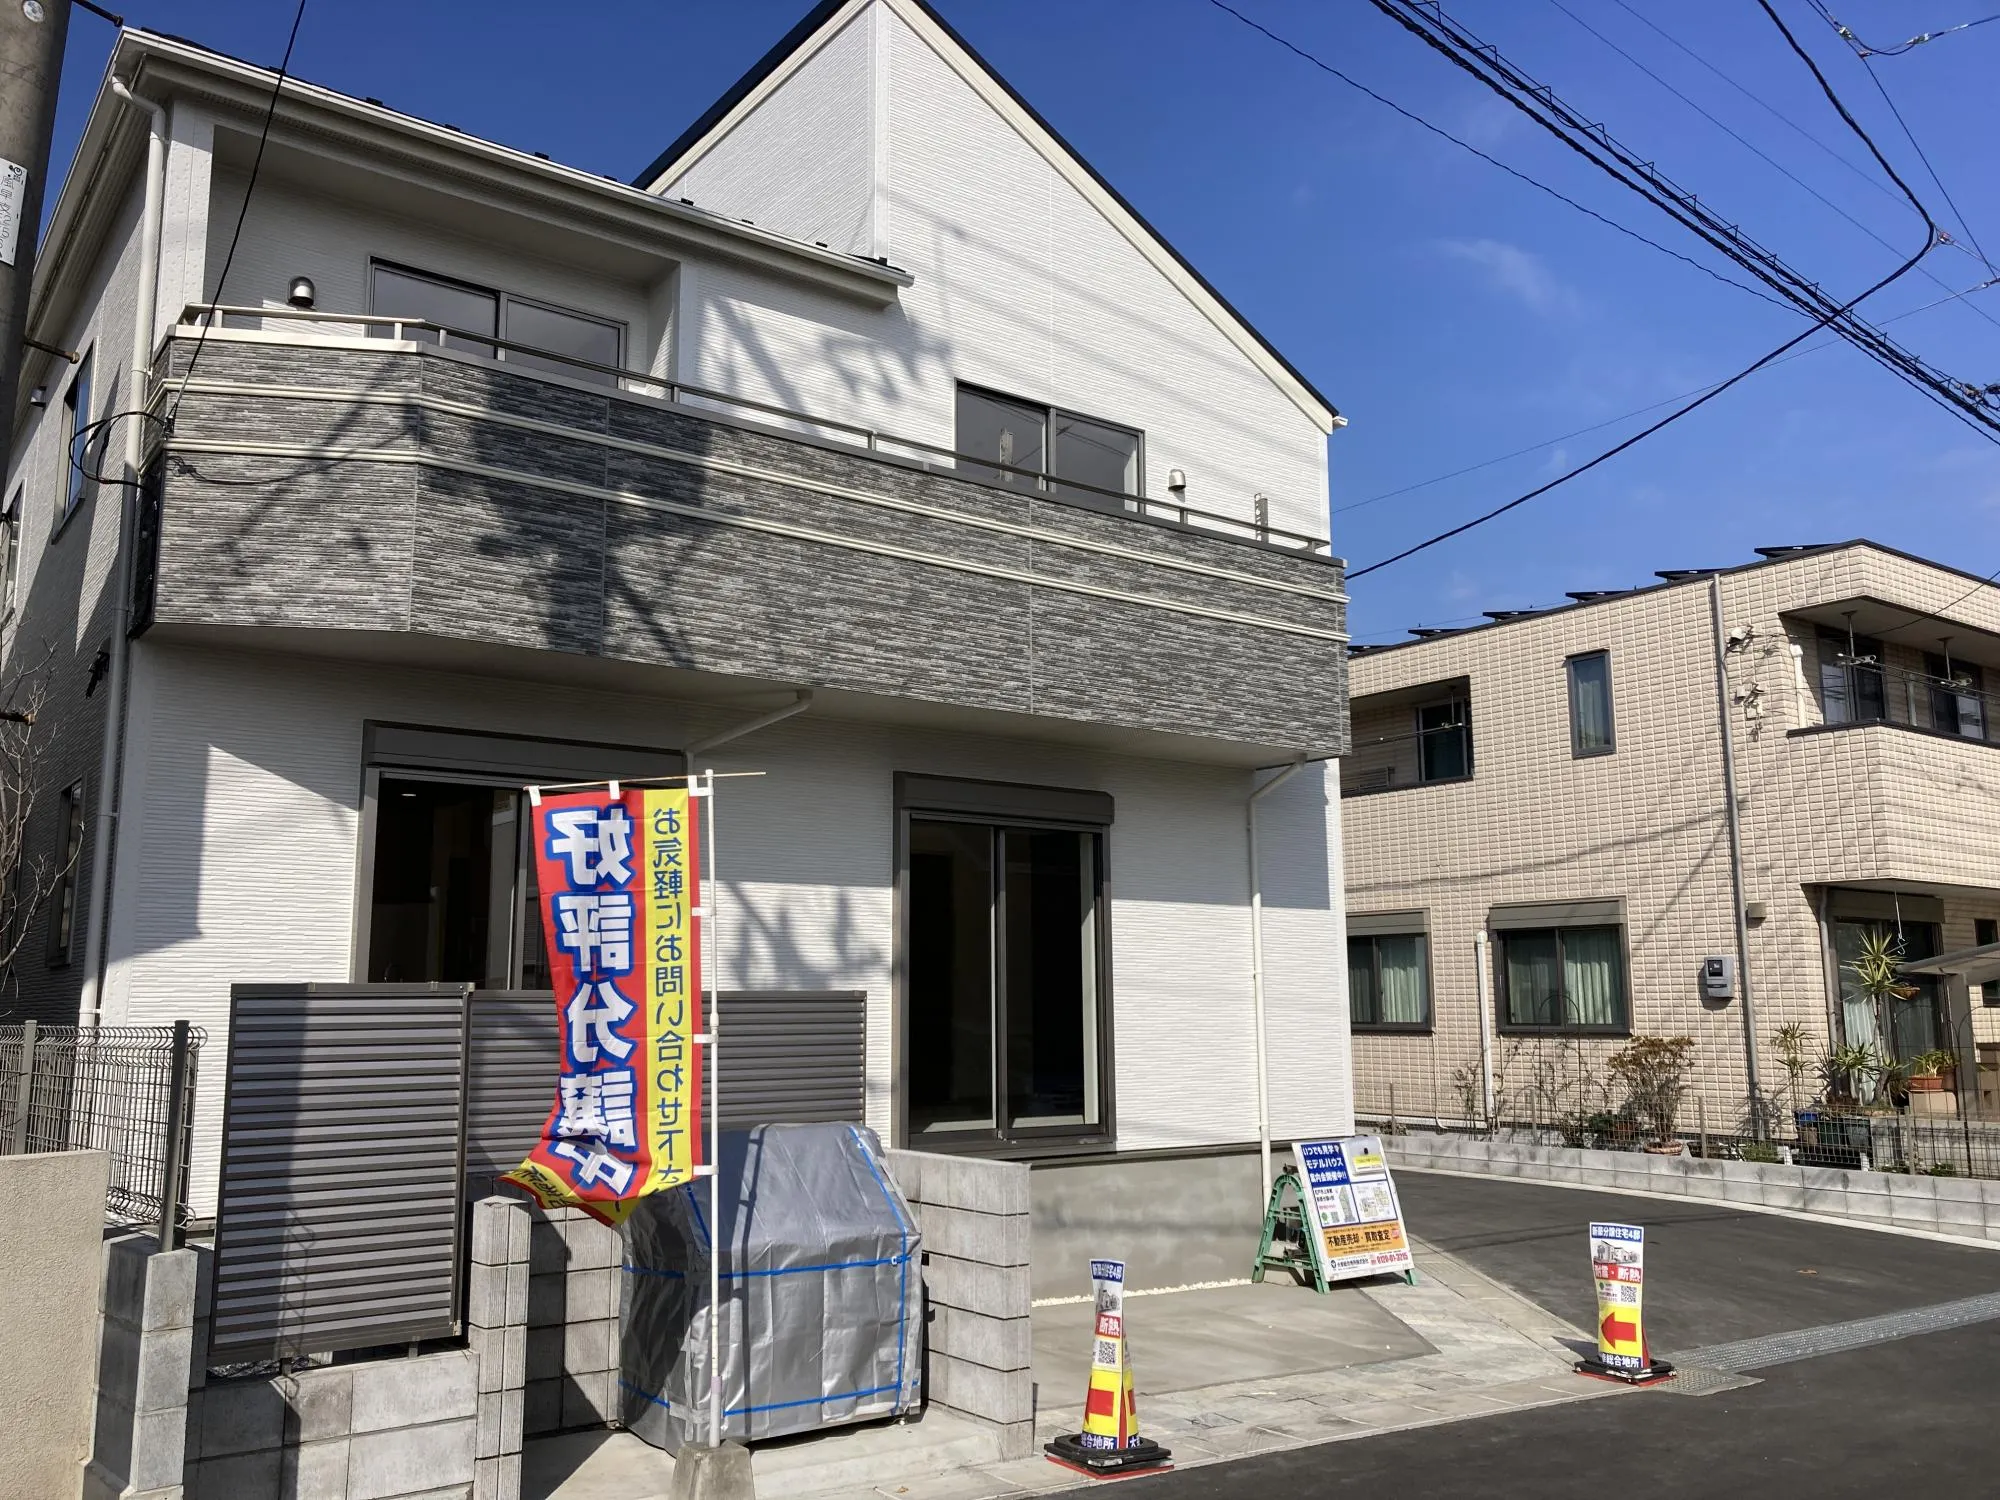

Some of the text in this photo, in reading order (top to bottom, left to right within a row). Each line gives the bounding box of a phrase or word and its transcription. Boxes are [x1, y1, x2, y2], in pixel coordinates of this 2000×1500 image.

[1306, 1157, 1344, 1169] モデルハウス
